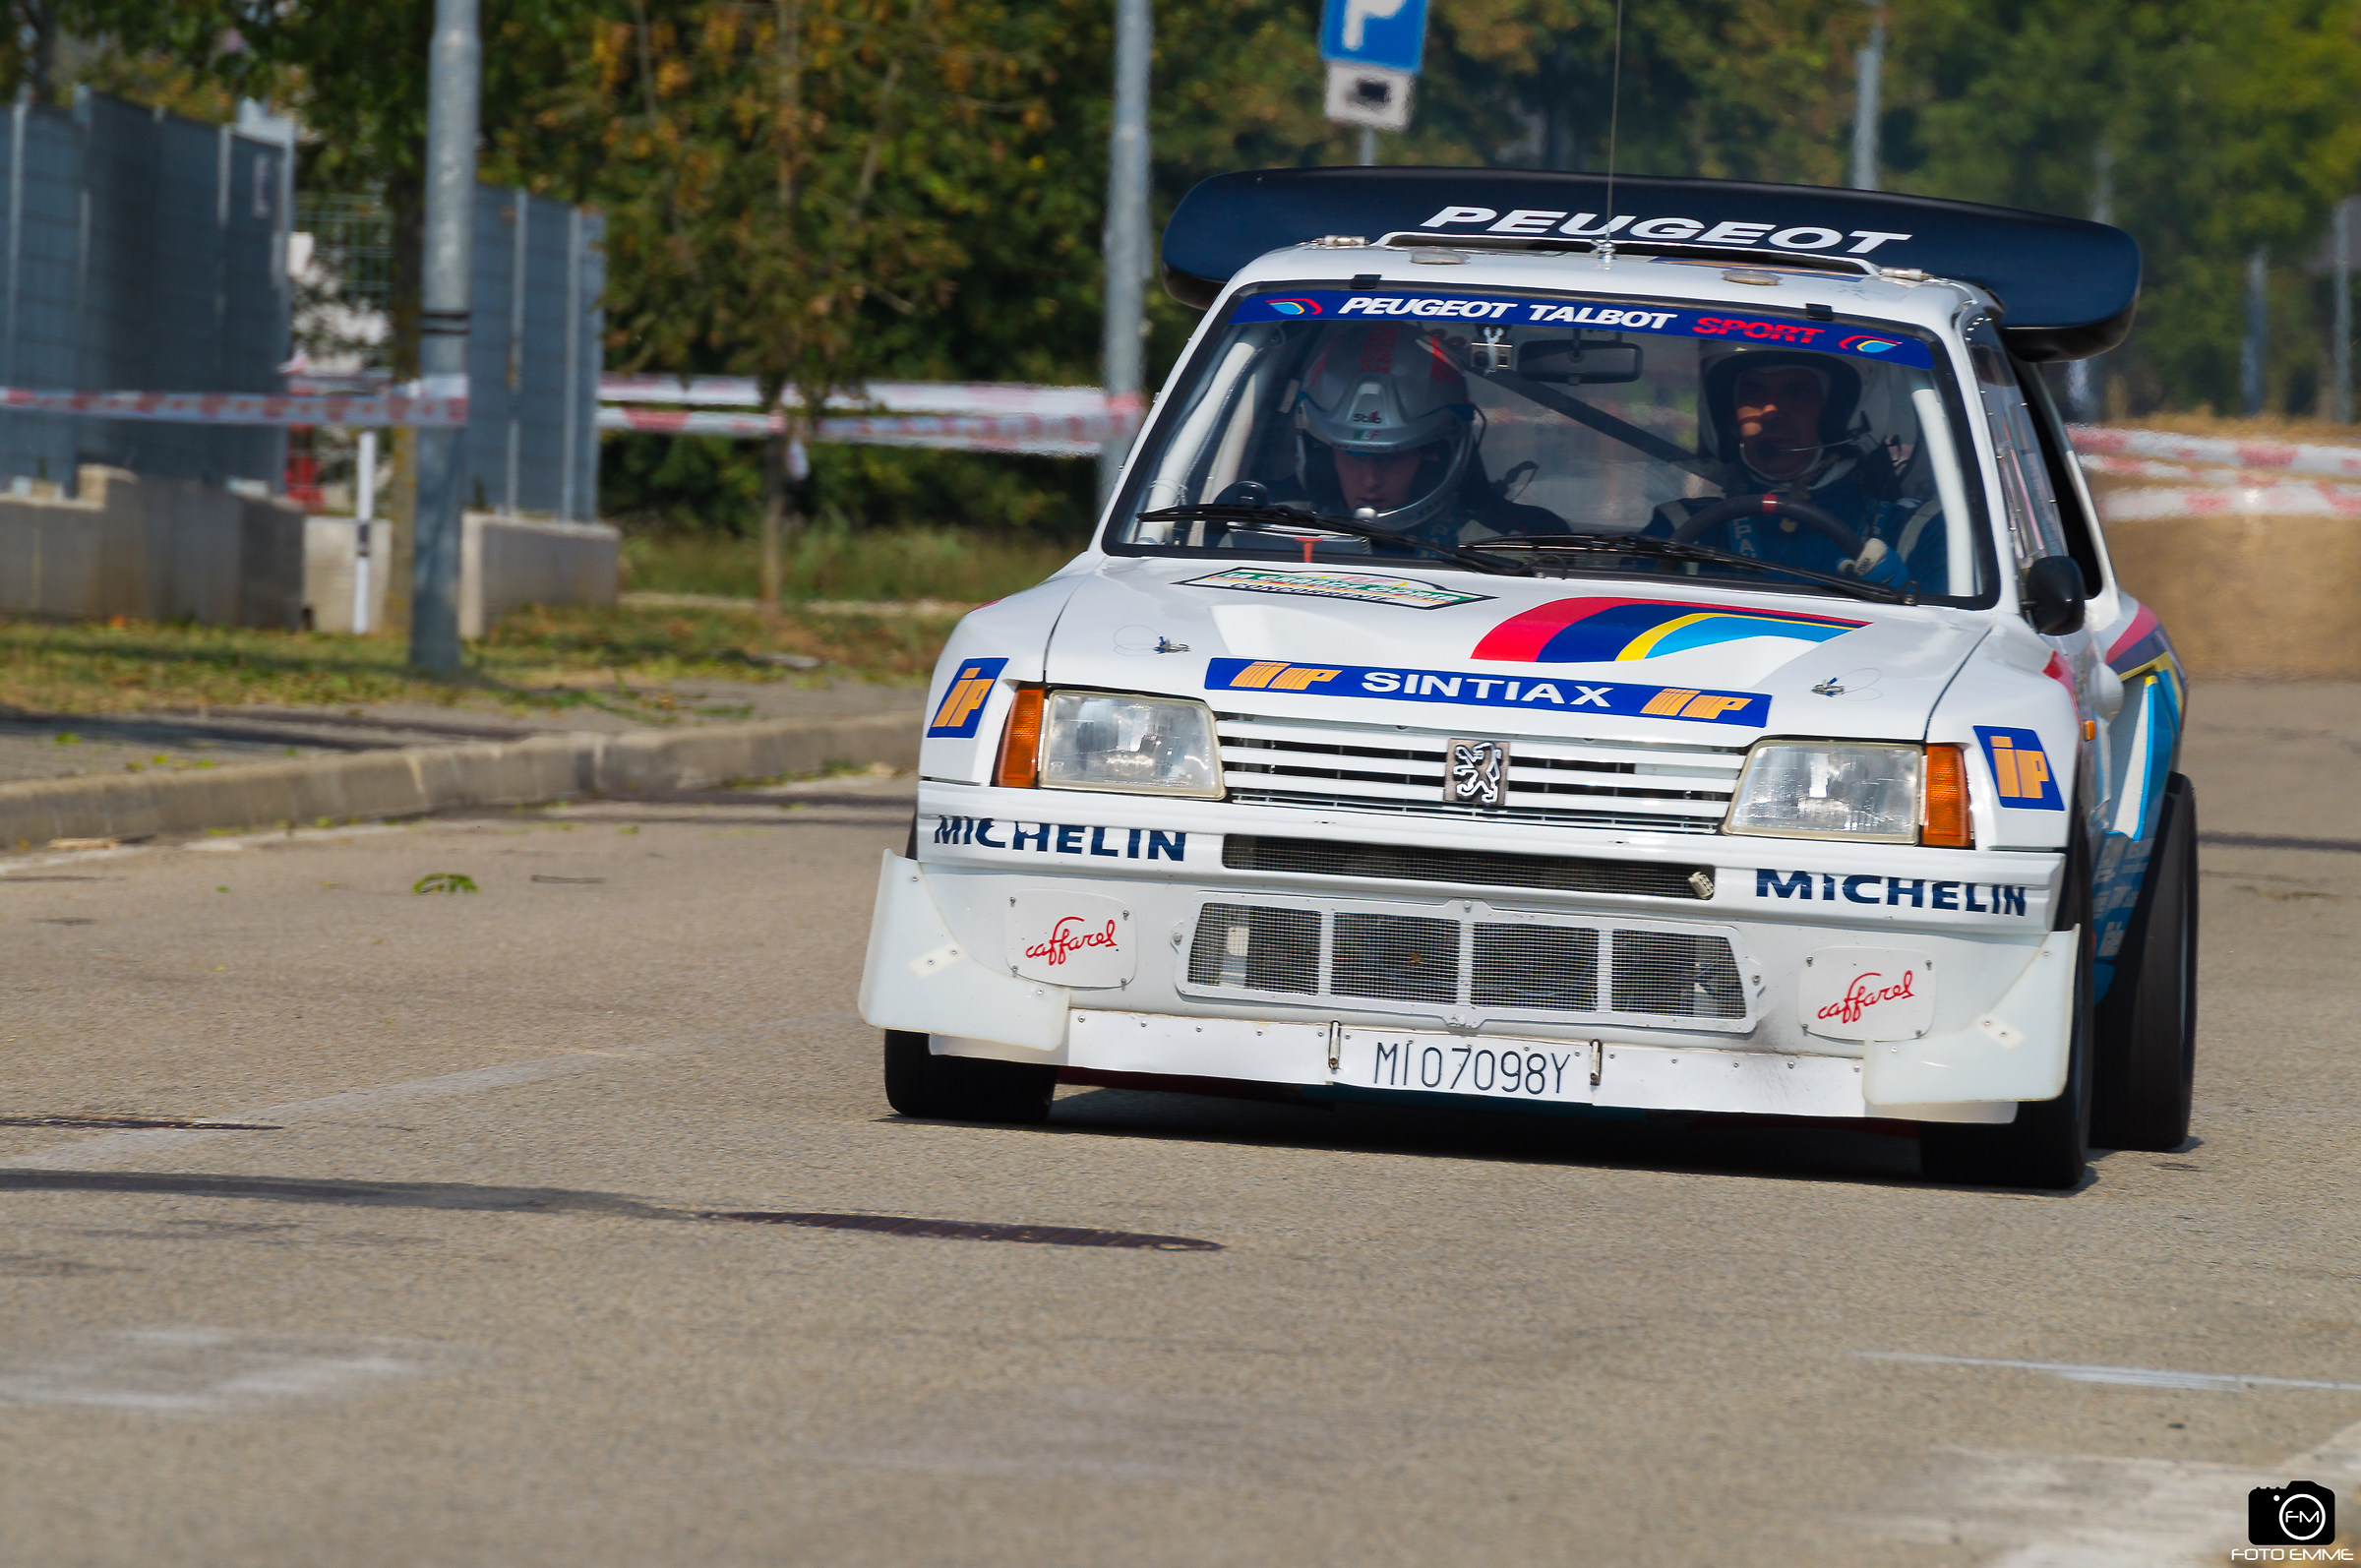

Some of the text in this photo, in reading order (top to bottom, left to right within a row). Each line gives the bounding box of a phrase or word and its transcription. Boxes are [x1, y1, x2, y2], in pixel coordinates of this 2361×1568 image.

[1420, 206, 1912, 254] PEUGEOT
[1338, 297, 1826, 343] PEUGEOT TALBOT SPORT
[1362, 672, 1613, 707] SINTIAX
[934, 814, 1186, 862] MICHELIN
[1756, 869, 2027, 917] MICHELIN
